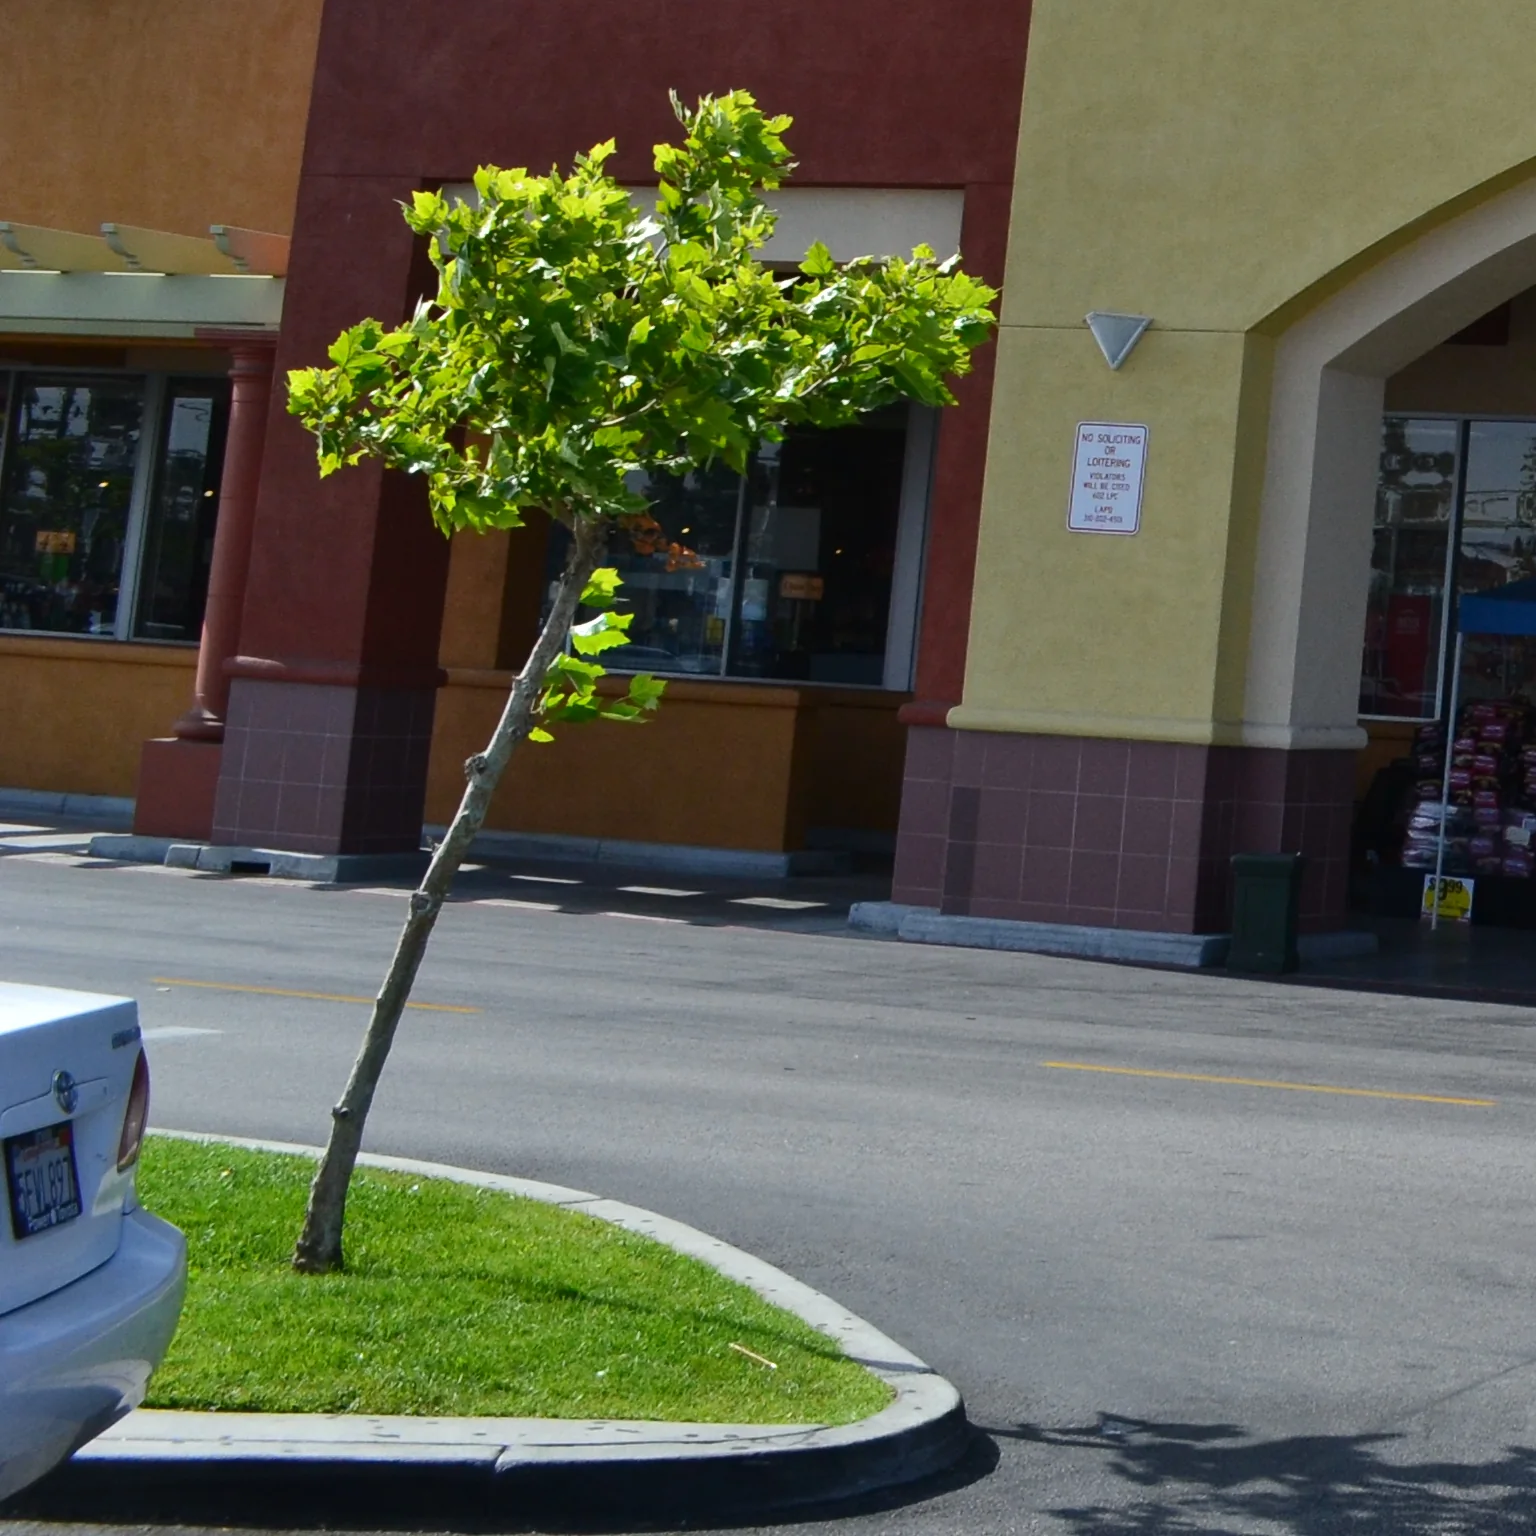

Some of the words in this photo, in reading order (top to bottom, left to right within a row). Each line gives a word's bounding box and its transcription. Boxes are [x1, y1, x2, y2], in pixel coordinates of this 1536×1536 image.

[1082, 433, 1093, 442] NO
[1098, 434, 1141, 444] SOLICITING
[1104, 446, 1116, 455] OR
[1087, 457, 1131, 468] LOITERING
[1090, 472, 1126, 480] VIOLATORS
